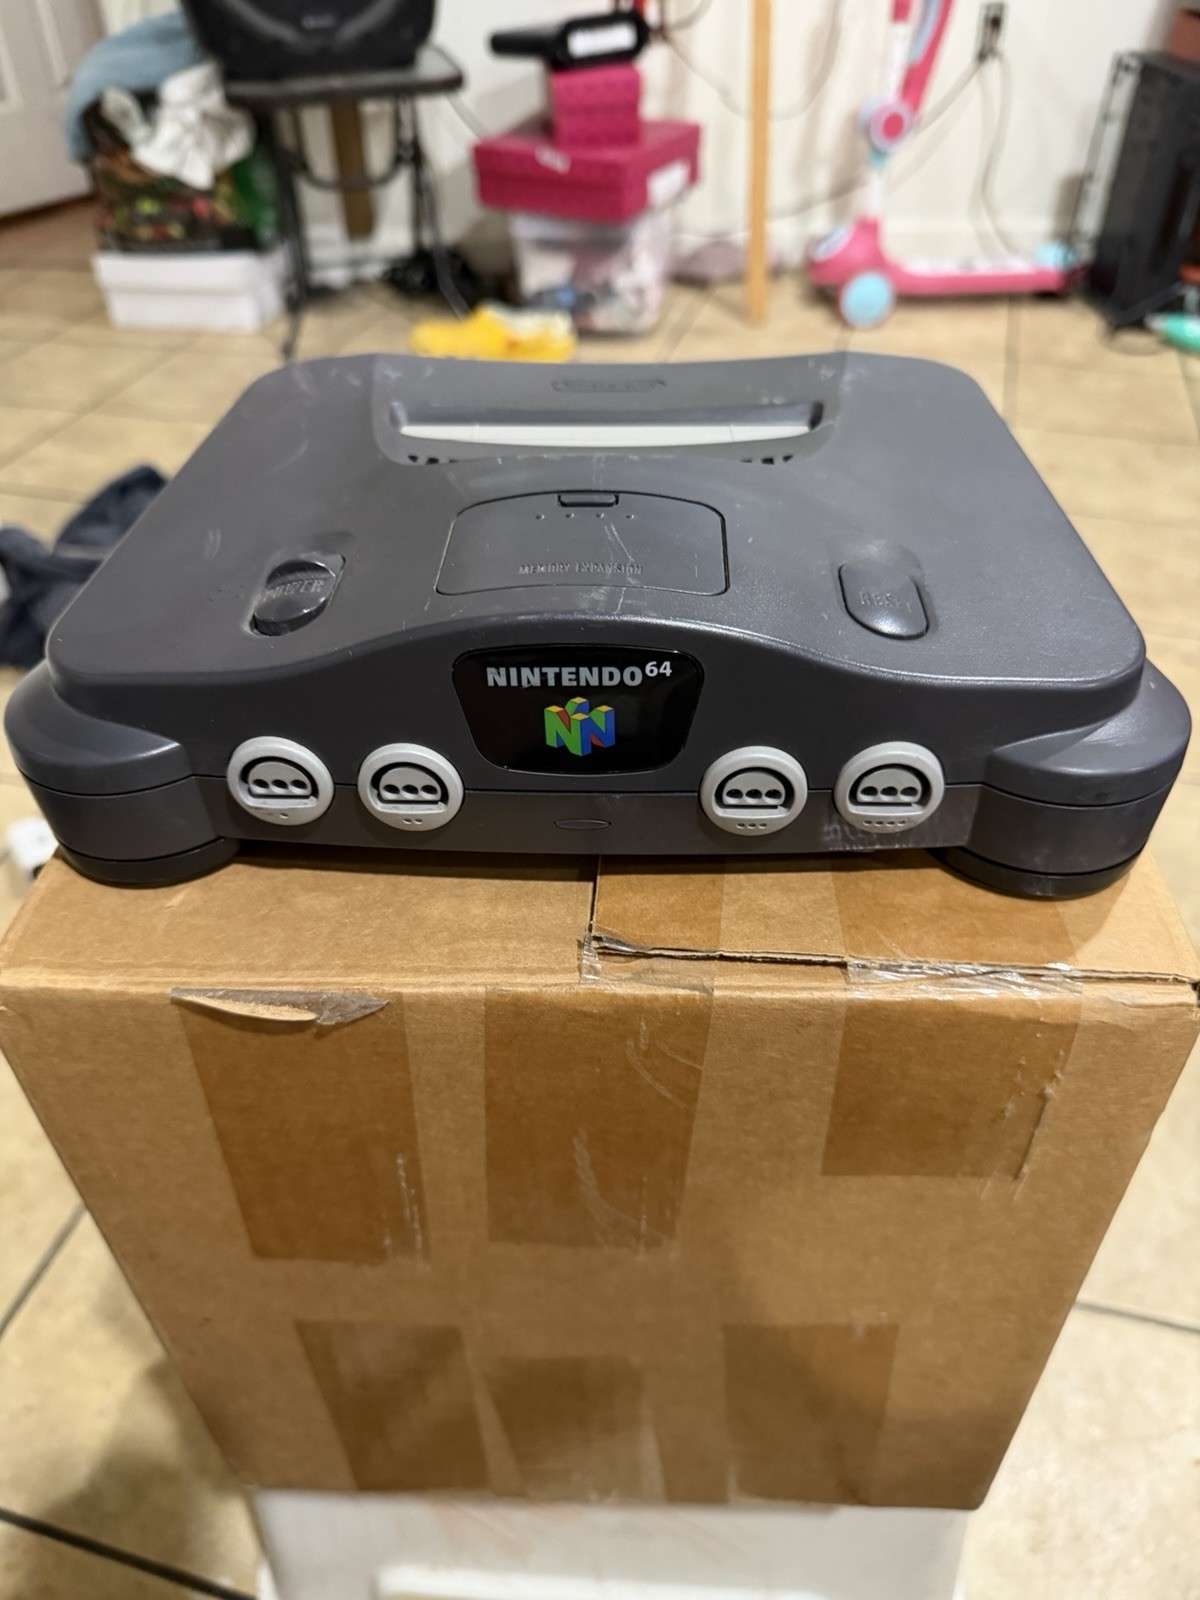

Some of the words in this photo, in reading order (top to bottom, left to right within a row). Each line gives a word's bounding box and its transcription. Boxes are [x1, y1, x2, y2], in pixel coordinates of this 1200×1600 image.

[519, 562, 571, 575] MEMORY
[575, 562, 642, 575] EXPANSION
[486, 666, 643, 688] NINTENDO
